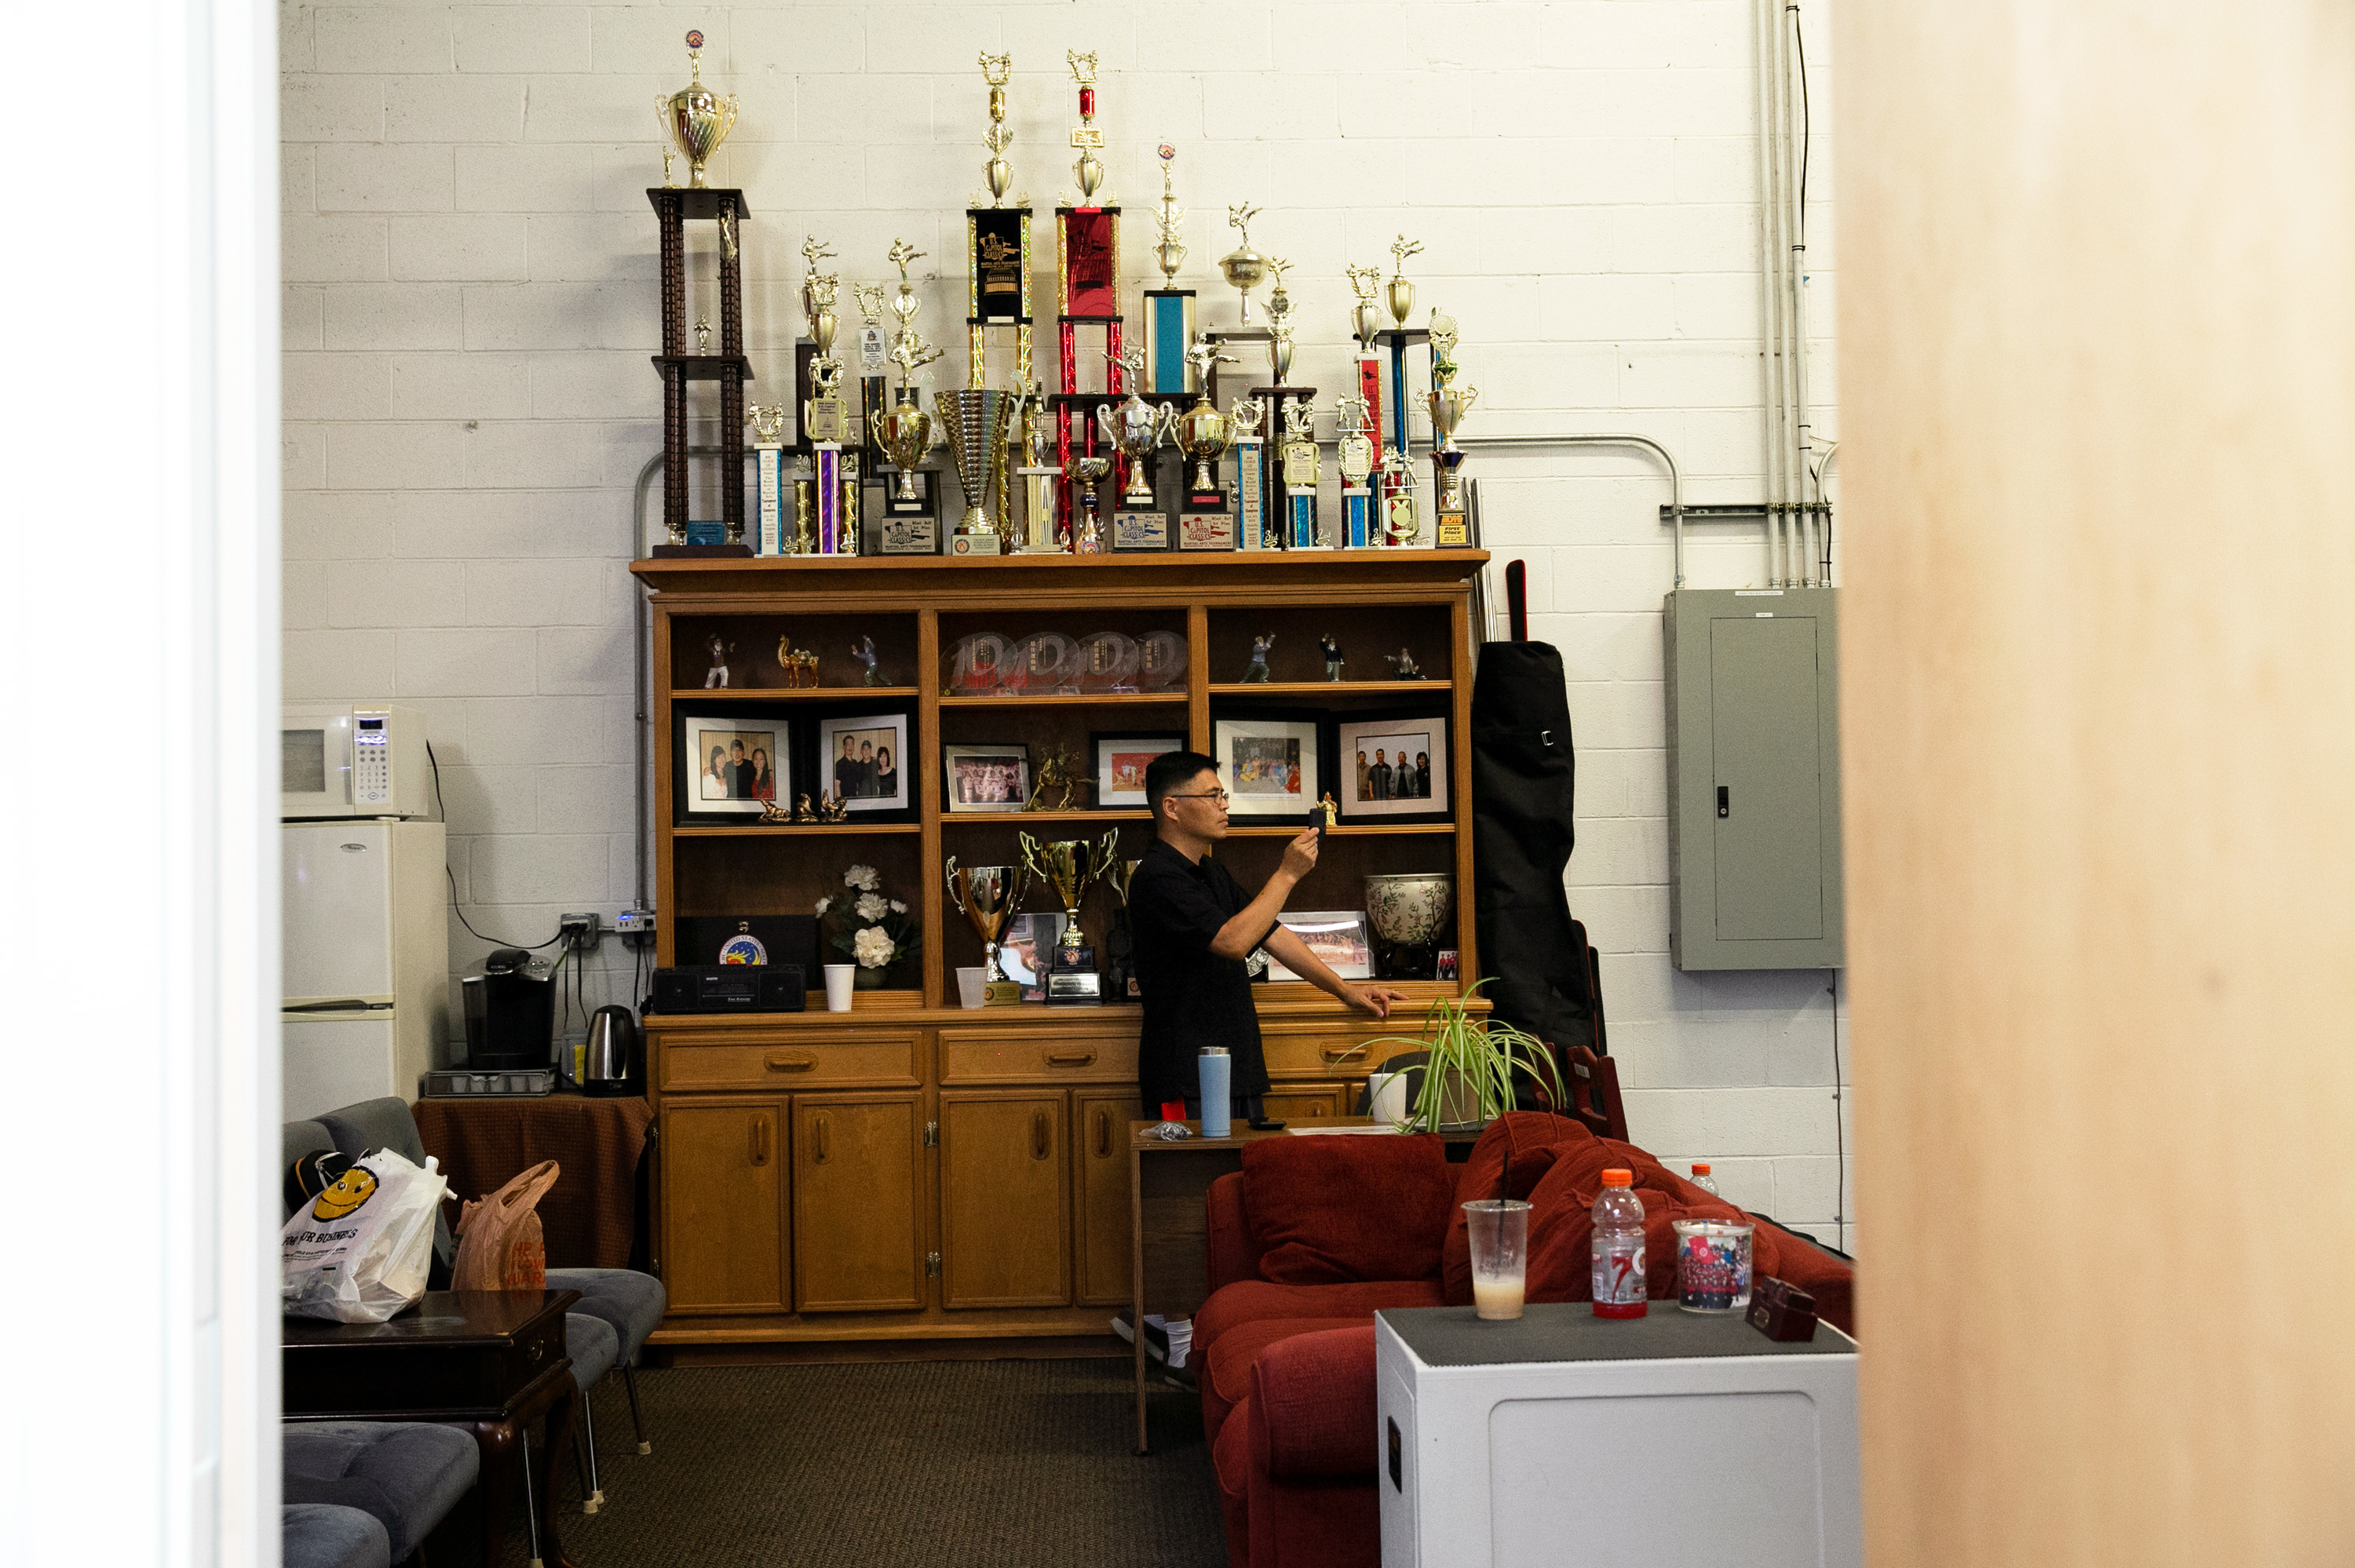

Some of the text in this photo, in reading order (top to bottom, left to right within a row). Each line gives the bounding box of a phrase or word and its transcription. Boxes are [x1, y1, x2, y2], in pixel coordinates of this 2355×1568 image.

[796, 454, 809, 465] 20
[841, 454, 853, 465] 02
[1265, 529, 1278, 542] 3rd
[1317, 528, 1331, 539] 2nd
[785, 536, 798, 546] 3rd
[724, 935, 742, 951] UNITED
[741, 935, 760, 946] STATES
